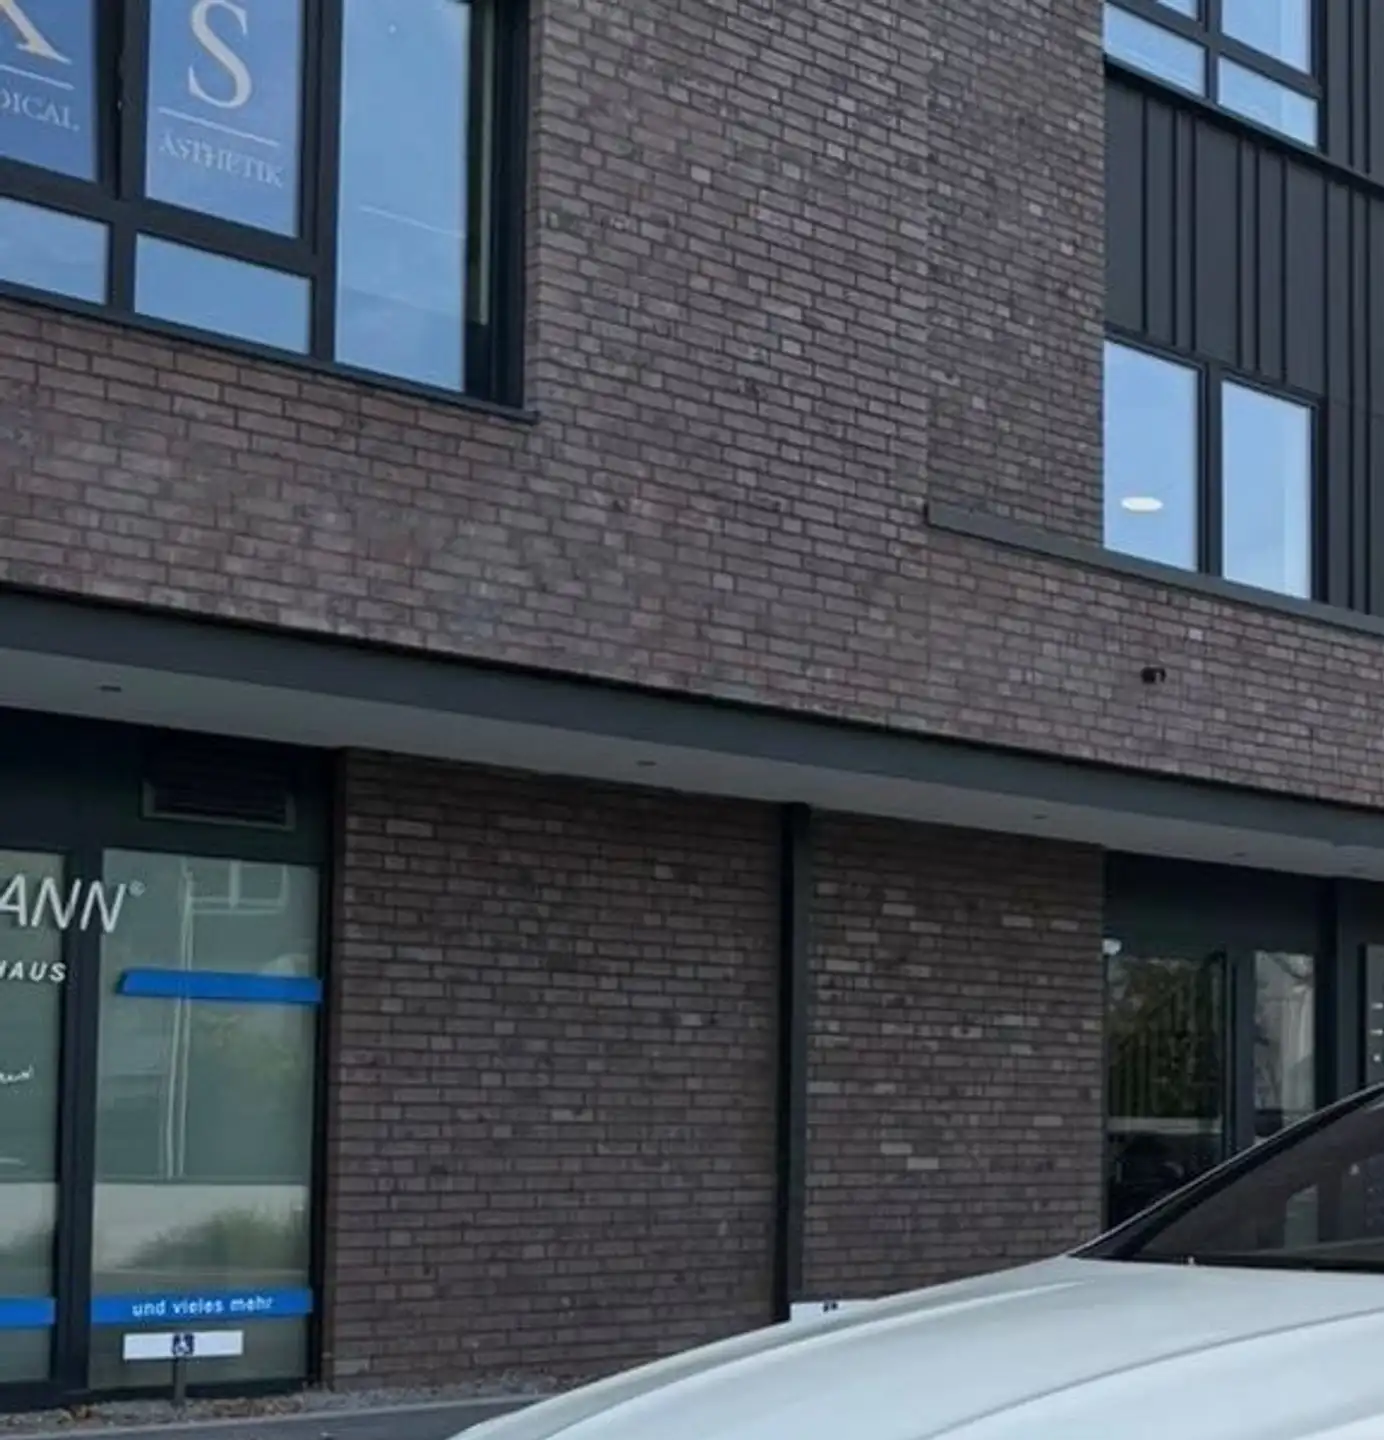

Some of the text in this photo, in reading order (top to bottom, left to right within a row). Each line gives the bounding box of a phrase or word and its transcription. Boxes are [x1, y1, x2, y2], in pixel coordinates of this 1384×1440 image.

[189, 0, 251, 109] S
[131, 1296, 273, 1318] und vieles mehr
